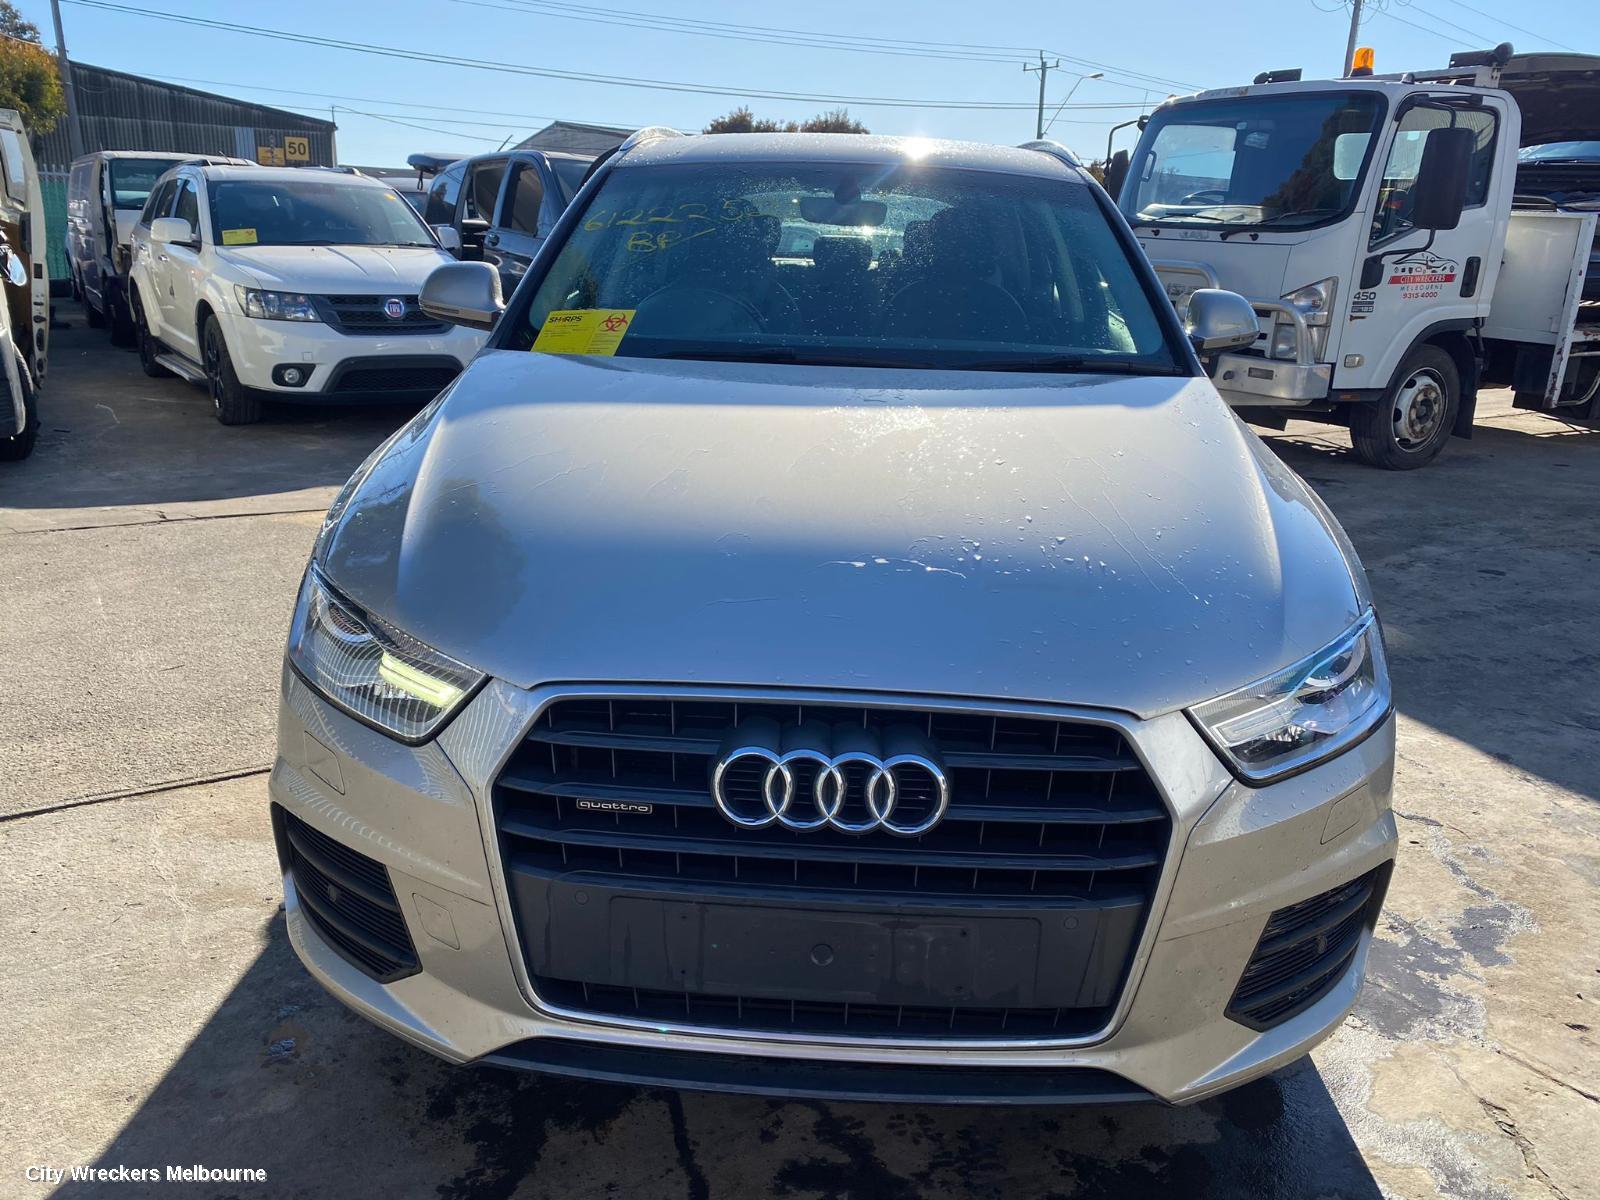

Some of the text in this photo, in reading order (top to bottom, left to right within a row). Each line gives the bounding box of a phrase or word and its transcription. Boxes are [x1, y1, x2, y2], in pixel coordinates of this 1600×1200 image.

[287, 141, 306, 155] 50
[1400, 283, 1443, 291] MELBOURNE
[1353, 291, 1377, 300] 450
[579, 801, 649, 812] quattro
